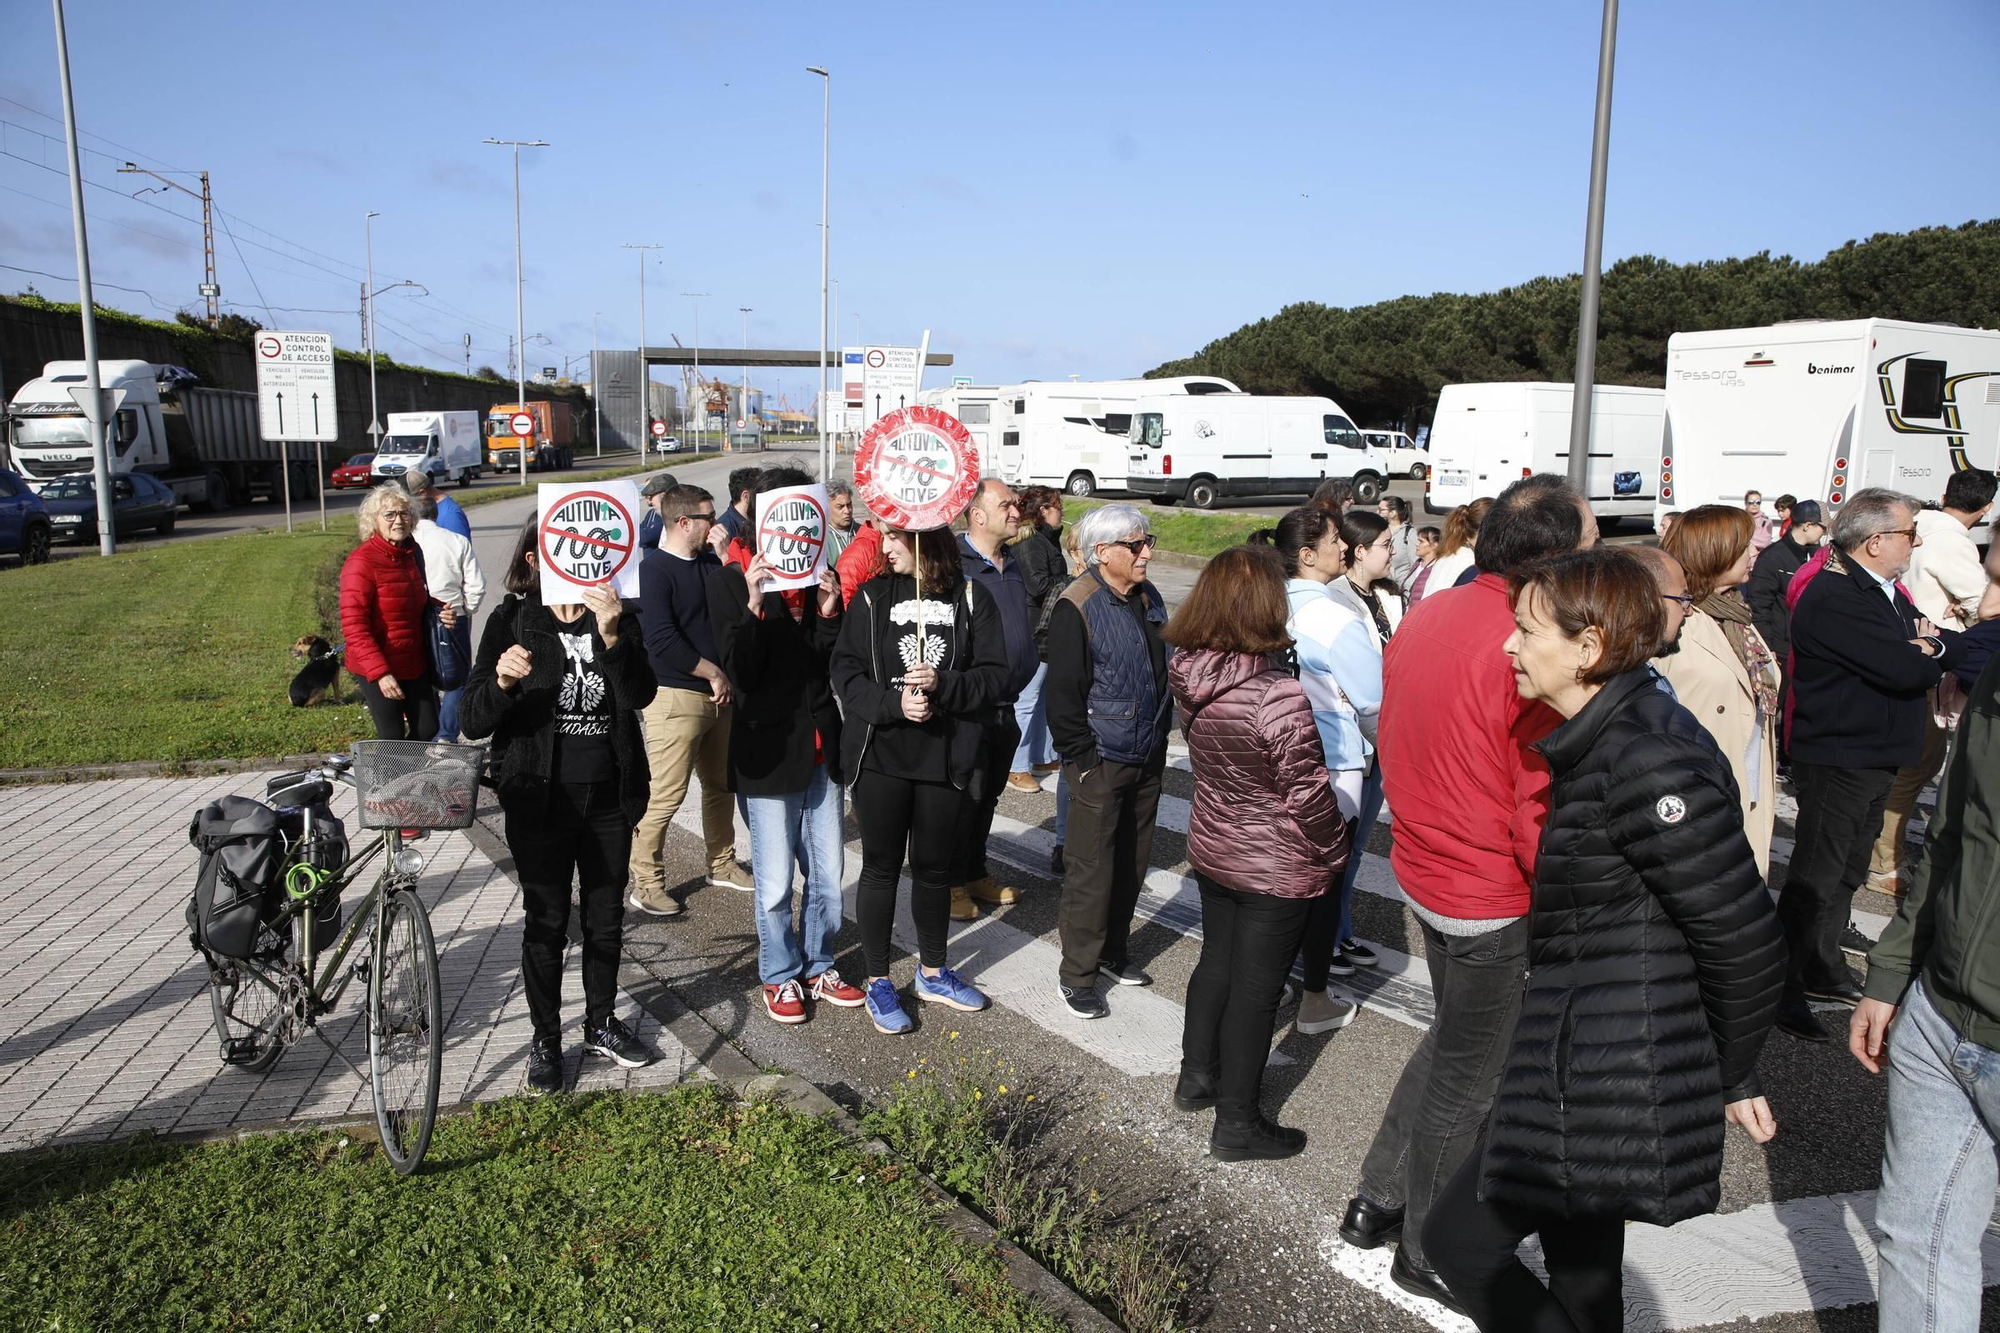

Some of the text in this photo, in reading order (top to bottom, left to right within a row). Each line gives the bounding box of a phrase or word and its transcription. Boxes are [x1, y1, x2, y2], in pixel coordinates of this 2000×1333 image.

[285, 335, 327, 343] ATENCION
[297, 354, 331, 362] ACCESO
[1807, 362, 1855, 374] benimar
[1674, 370, 1737, 380] Tessoro
[1899, 466, 1931, 477] Tessoro
[893, 488, 938, 503] JOVE
[564, 560, 611, 579] JOVE
[774, 555, 813, 573] JOVE
